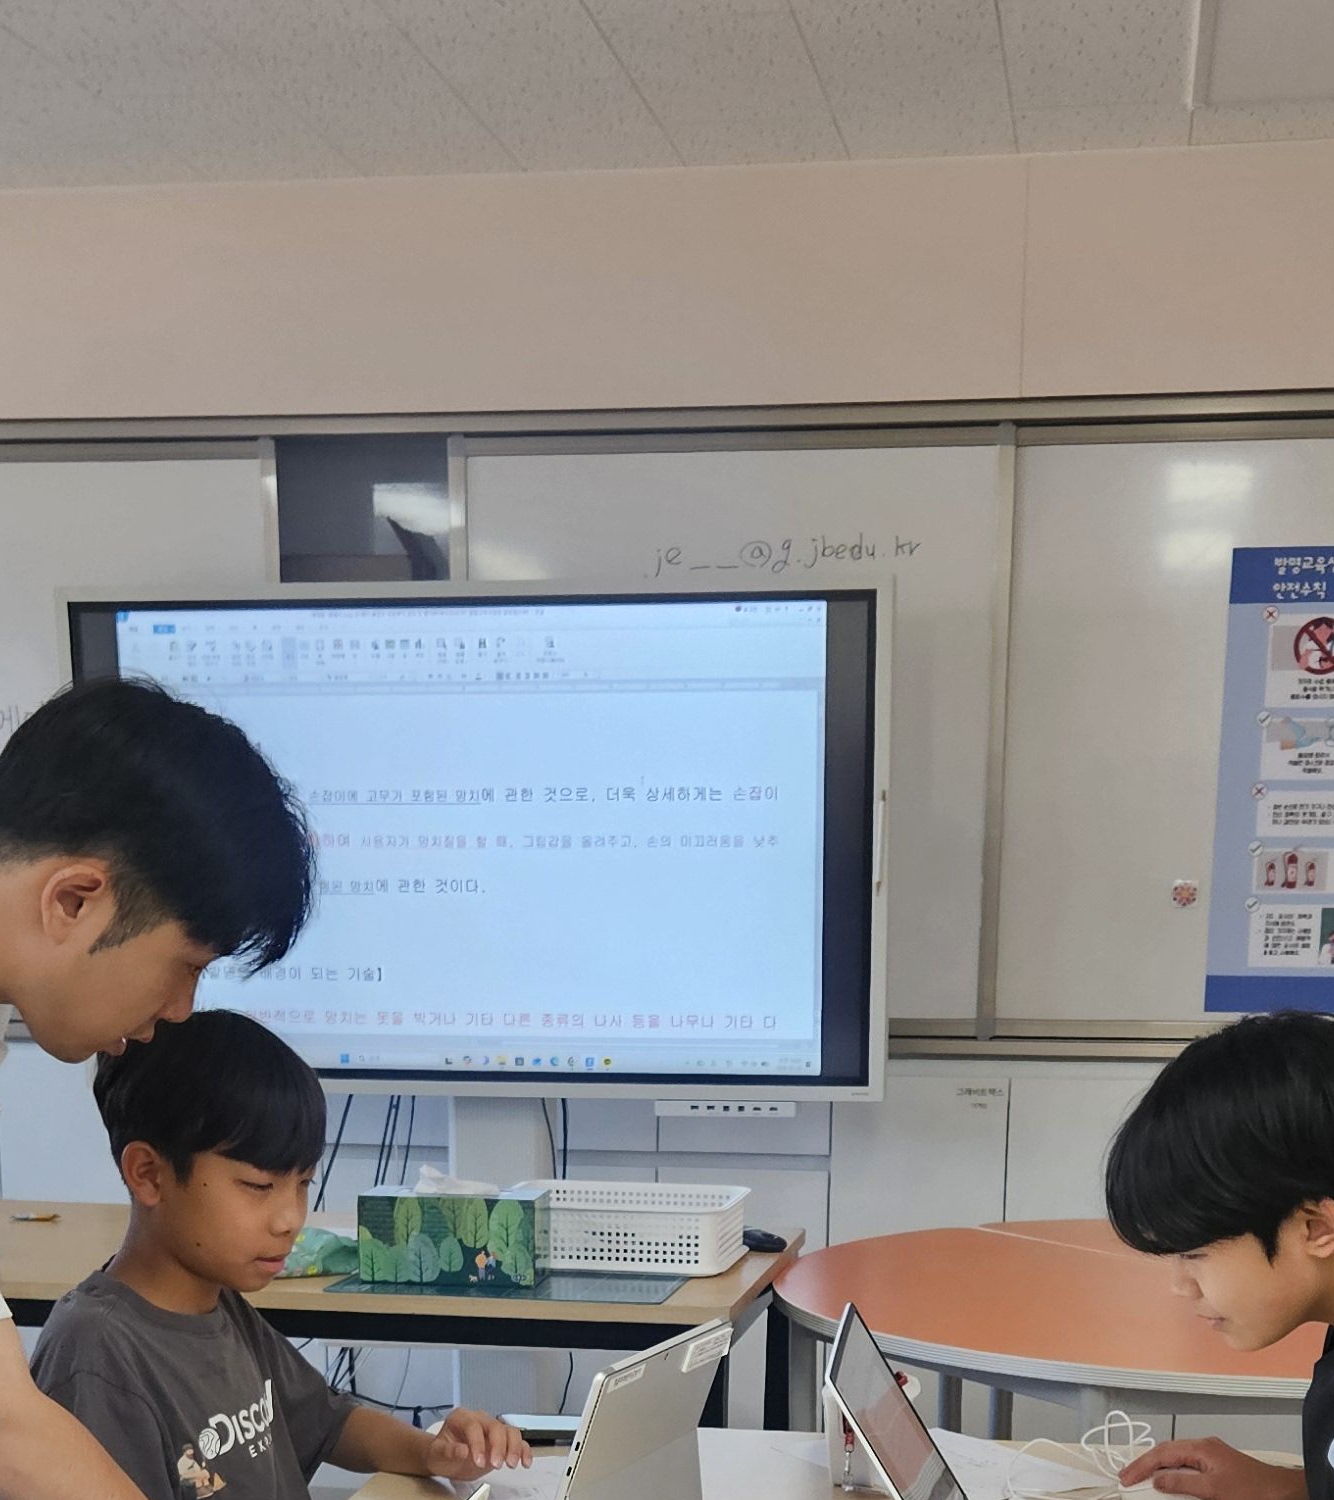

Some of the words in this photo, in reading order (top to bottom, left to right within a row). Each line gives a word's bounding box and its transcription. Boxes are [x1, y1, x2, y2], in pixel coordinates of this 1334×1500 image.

[1272, 581, 1327, 600] 안전수칙
[504, 787, 534, 803] 관한
[606, 786, 636, 802] 더욱
[646, 786, 723, 802] 상세하게는
[398, 878, 426, 894] 관한
[435, 878, 487, 894] 것이다.
[310, 967, 339, 981] 되는
[466, 1011, 494, 1027] 기타
[503, 1012, 532, 1027] 다른
[540, 1012, 585, 1028] 종류의
[593, 1012, 623, 1028] 나사
[724, 1013, 754, 1029] 기타
